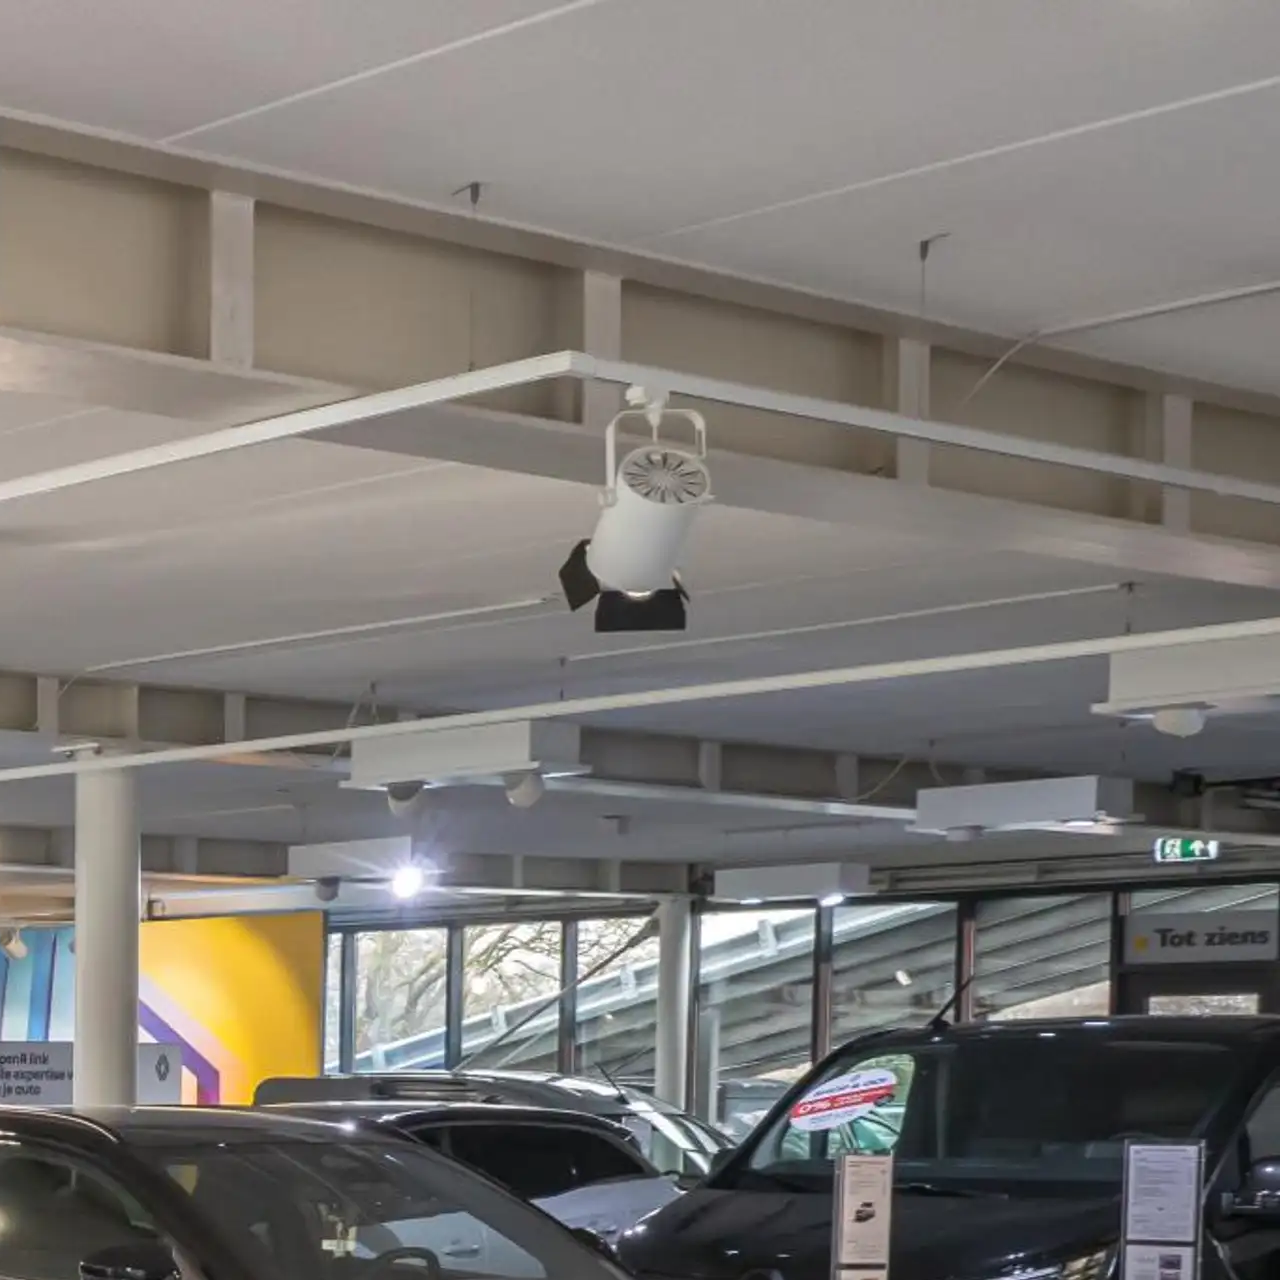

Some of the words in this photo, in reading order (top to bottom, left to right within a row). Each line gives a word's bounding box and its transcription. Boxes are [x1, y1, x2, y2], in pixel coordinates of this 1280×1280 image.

[1153, 928, 1197, 947] Tot
[1204, 925, 1270, 946] ziens
[13, 1069, 65, 1083] expertise
[15, 1085, 41, 1096] auto
